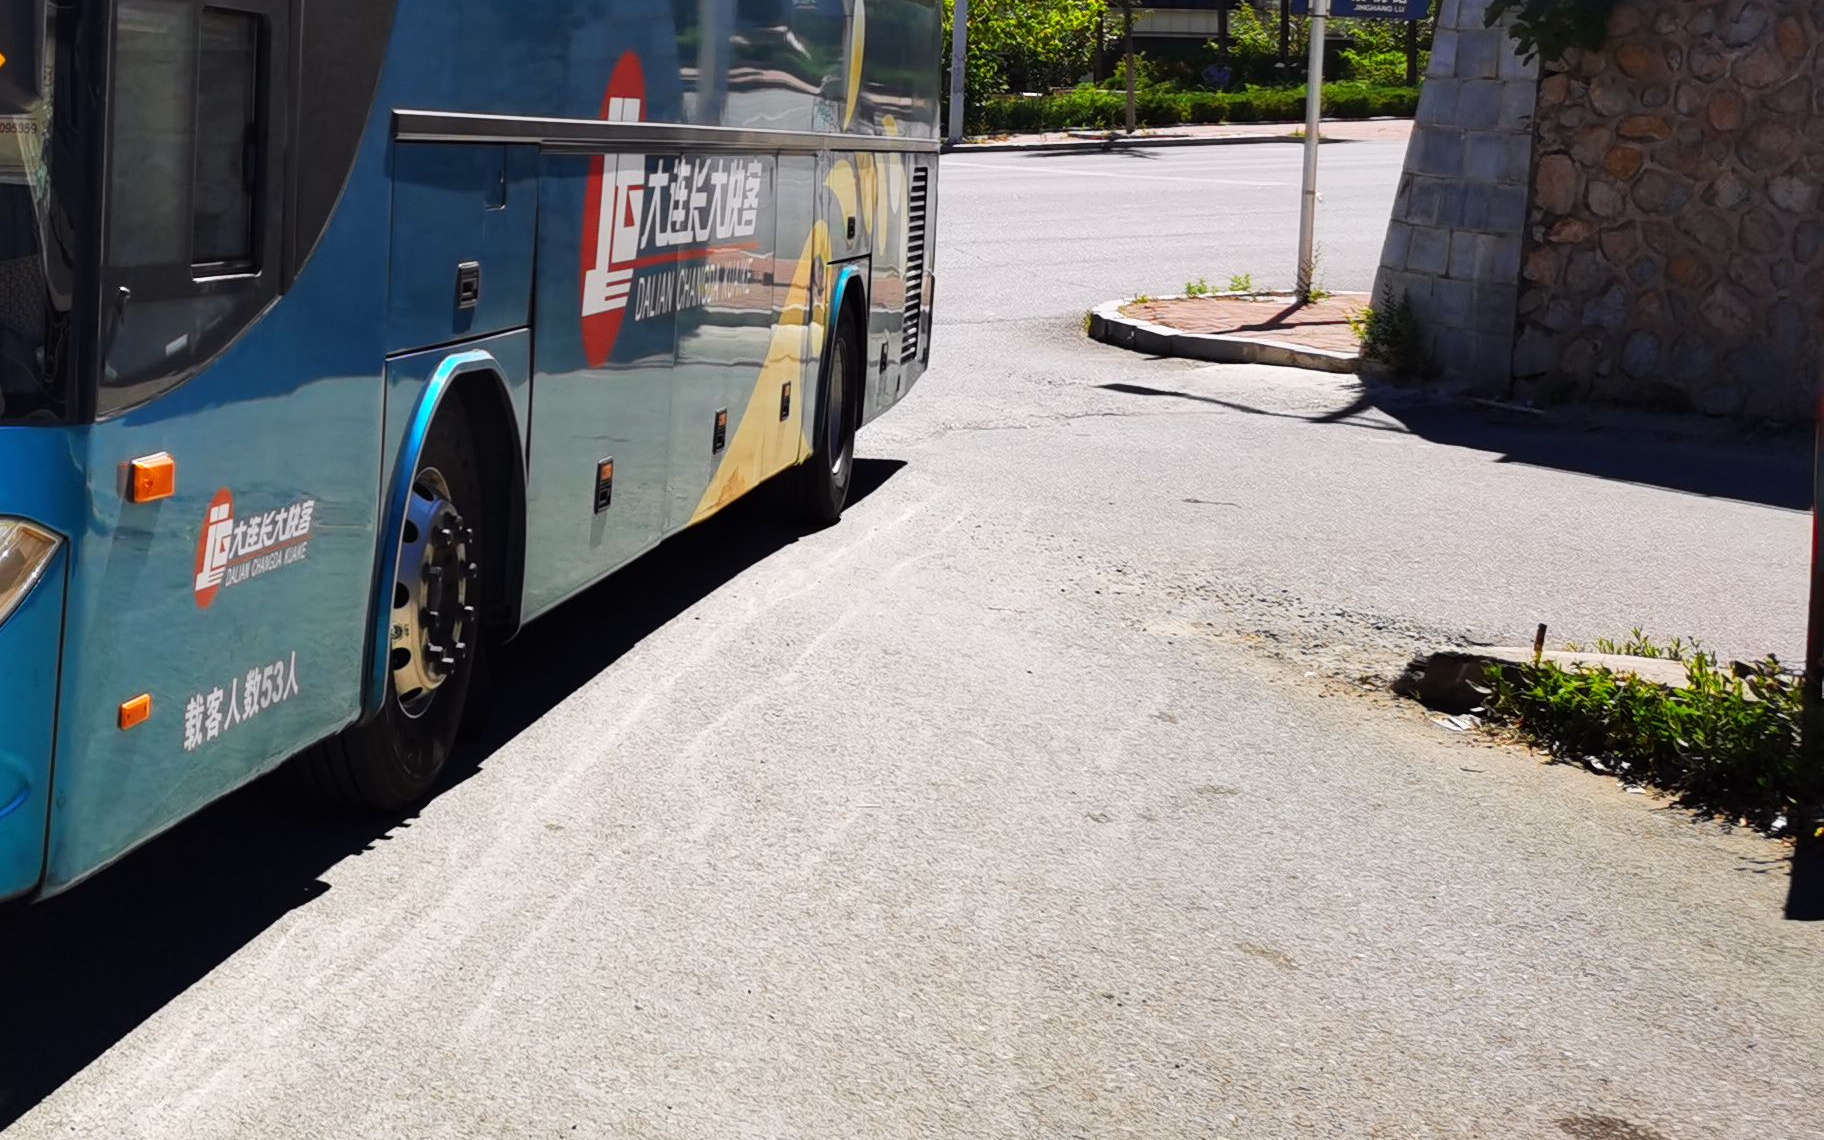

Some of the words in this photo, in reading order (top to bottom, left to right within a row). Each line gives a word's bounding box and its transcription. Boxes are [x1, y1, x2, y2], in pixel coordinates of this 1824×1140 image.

[635, 270, 674, 322] DALIAN
[229, 500, 315, 559] 大连长大快客
[183, 650, 299, 751] 载客人数53人
